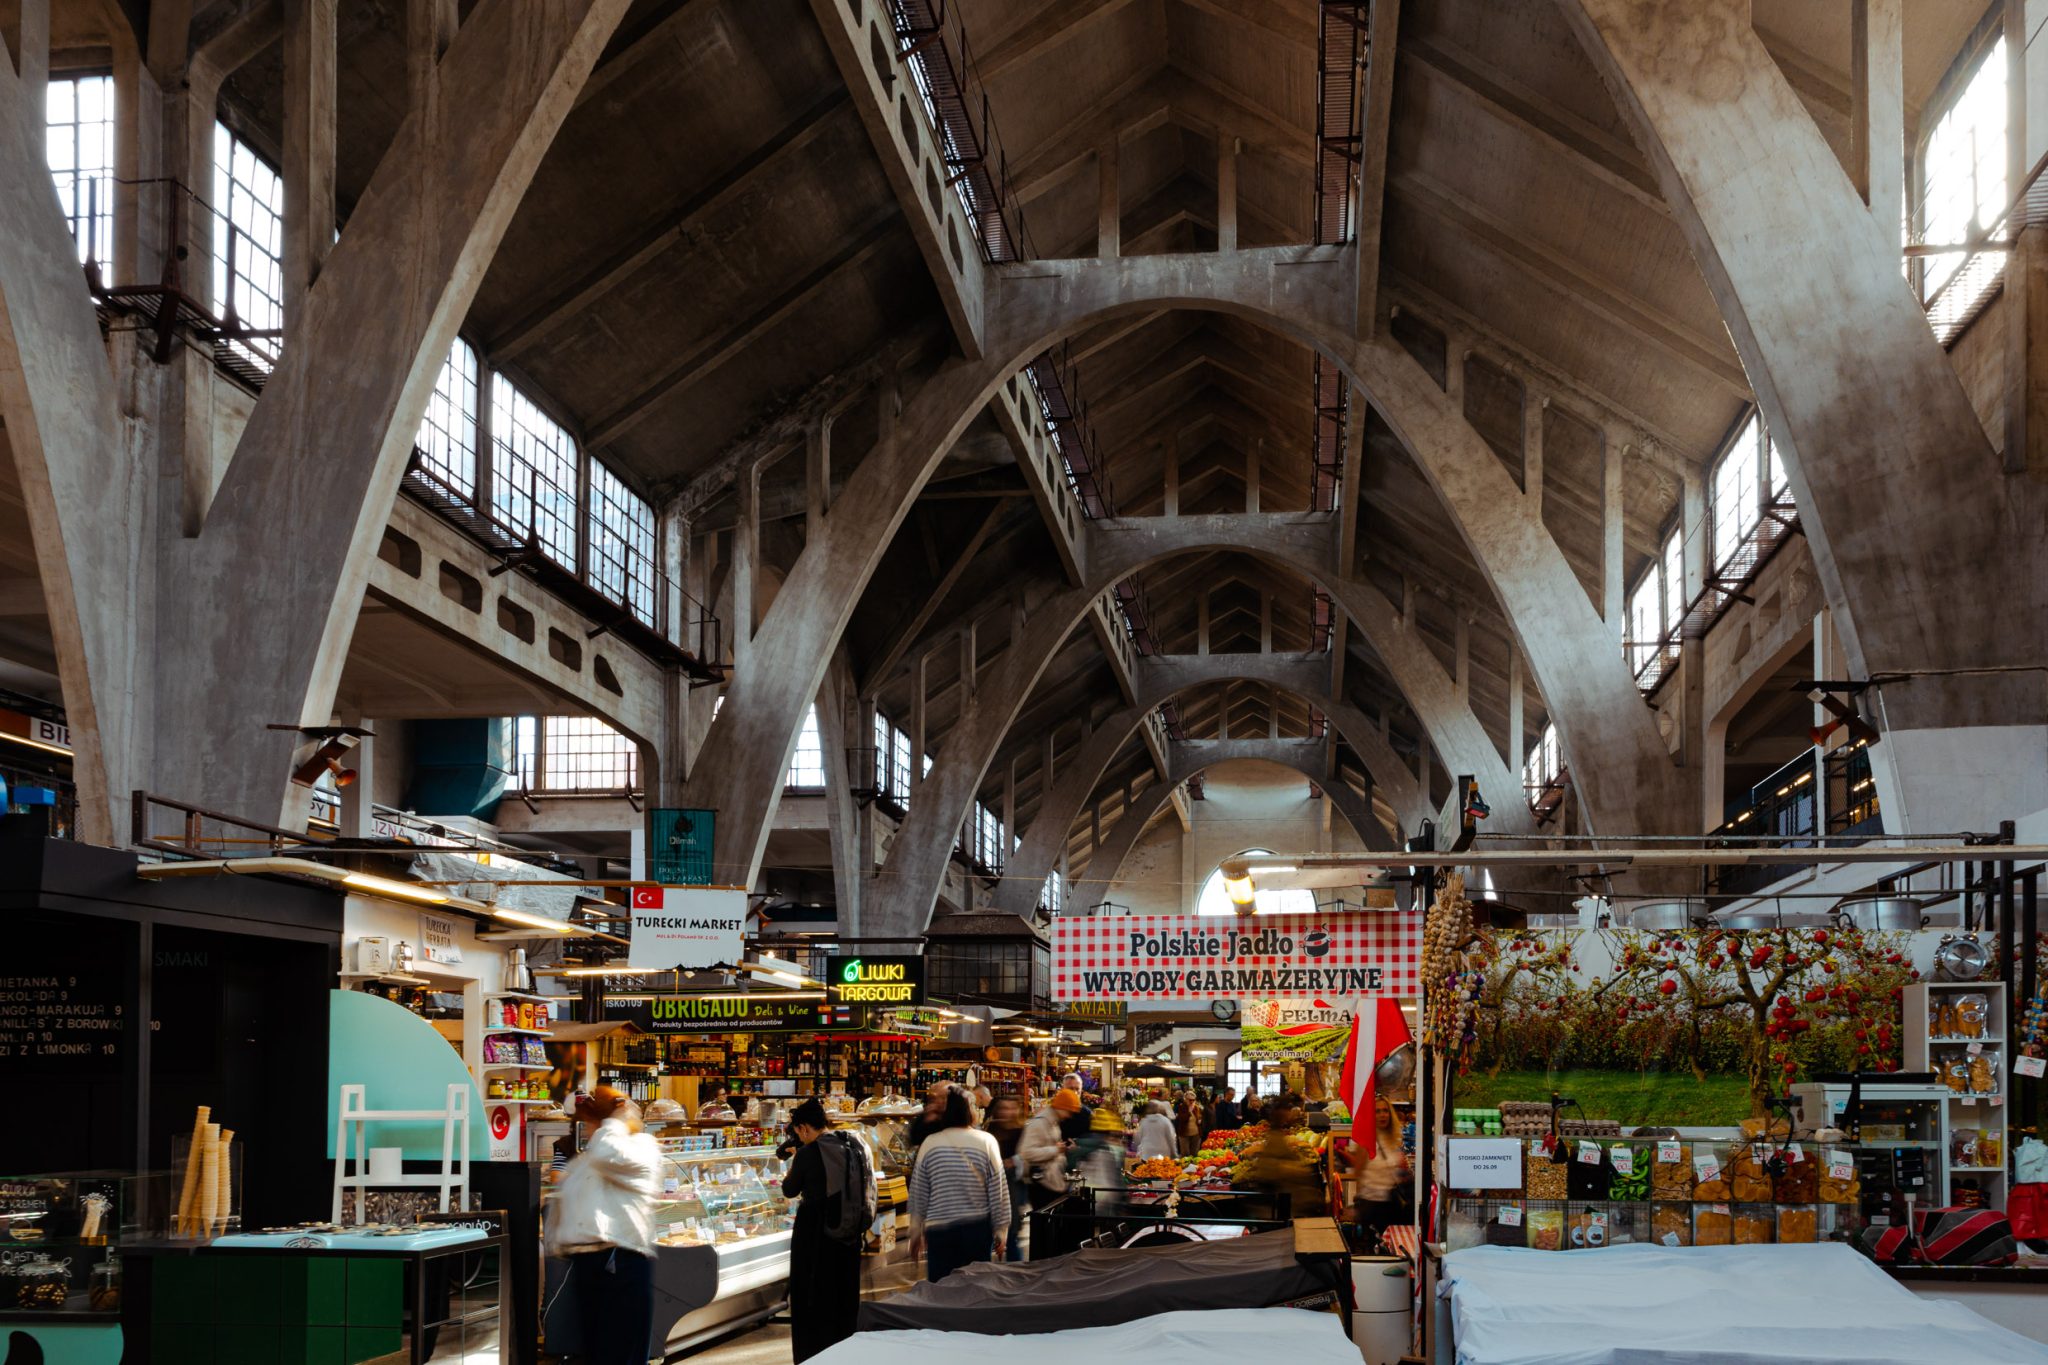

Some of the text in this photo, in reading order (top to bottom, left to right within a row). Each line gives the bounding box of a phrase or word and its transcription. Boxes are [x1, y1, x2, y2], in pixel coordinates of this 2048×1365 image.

[636, 916, 742, 930] TURECKI MARKET
[1130, 928, 1293, 962] Polskie Jadło
[154, 951, 209, 967] SMAKI
[844, 960, 904, 981] OLIWKI
[69, 976, 76, 987] 9
[1084, 961, 1382, 995] WYROBY GARMAŻERYJNE
[60, 990, 68, 1000] 9
[837, 983, 915, 1001] TARGOWA
[114, 1005, 122, 1016] 9
[754, 1003, 773, 1016] Deli
[788, 1004, 809, 1016] Wine
[1071, 1000, 1122, 1015] KWIATY
[652, 1018, 783, 1029] Produkty bezpośrednio od producentów
[42, 1032, 53, 1042] 10
[102, 1044, 115, 1055] 10
